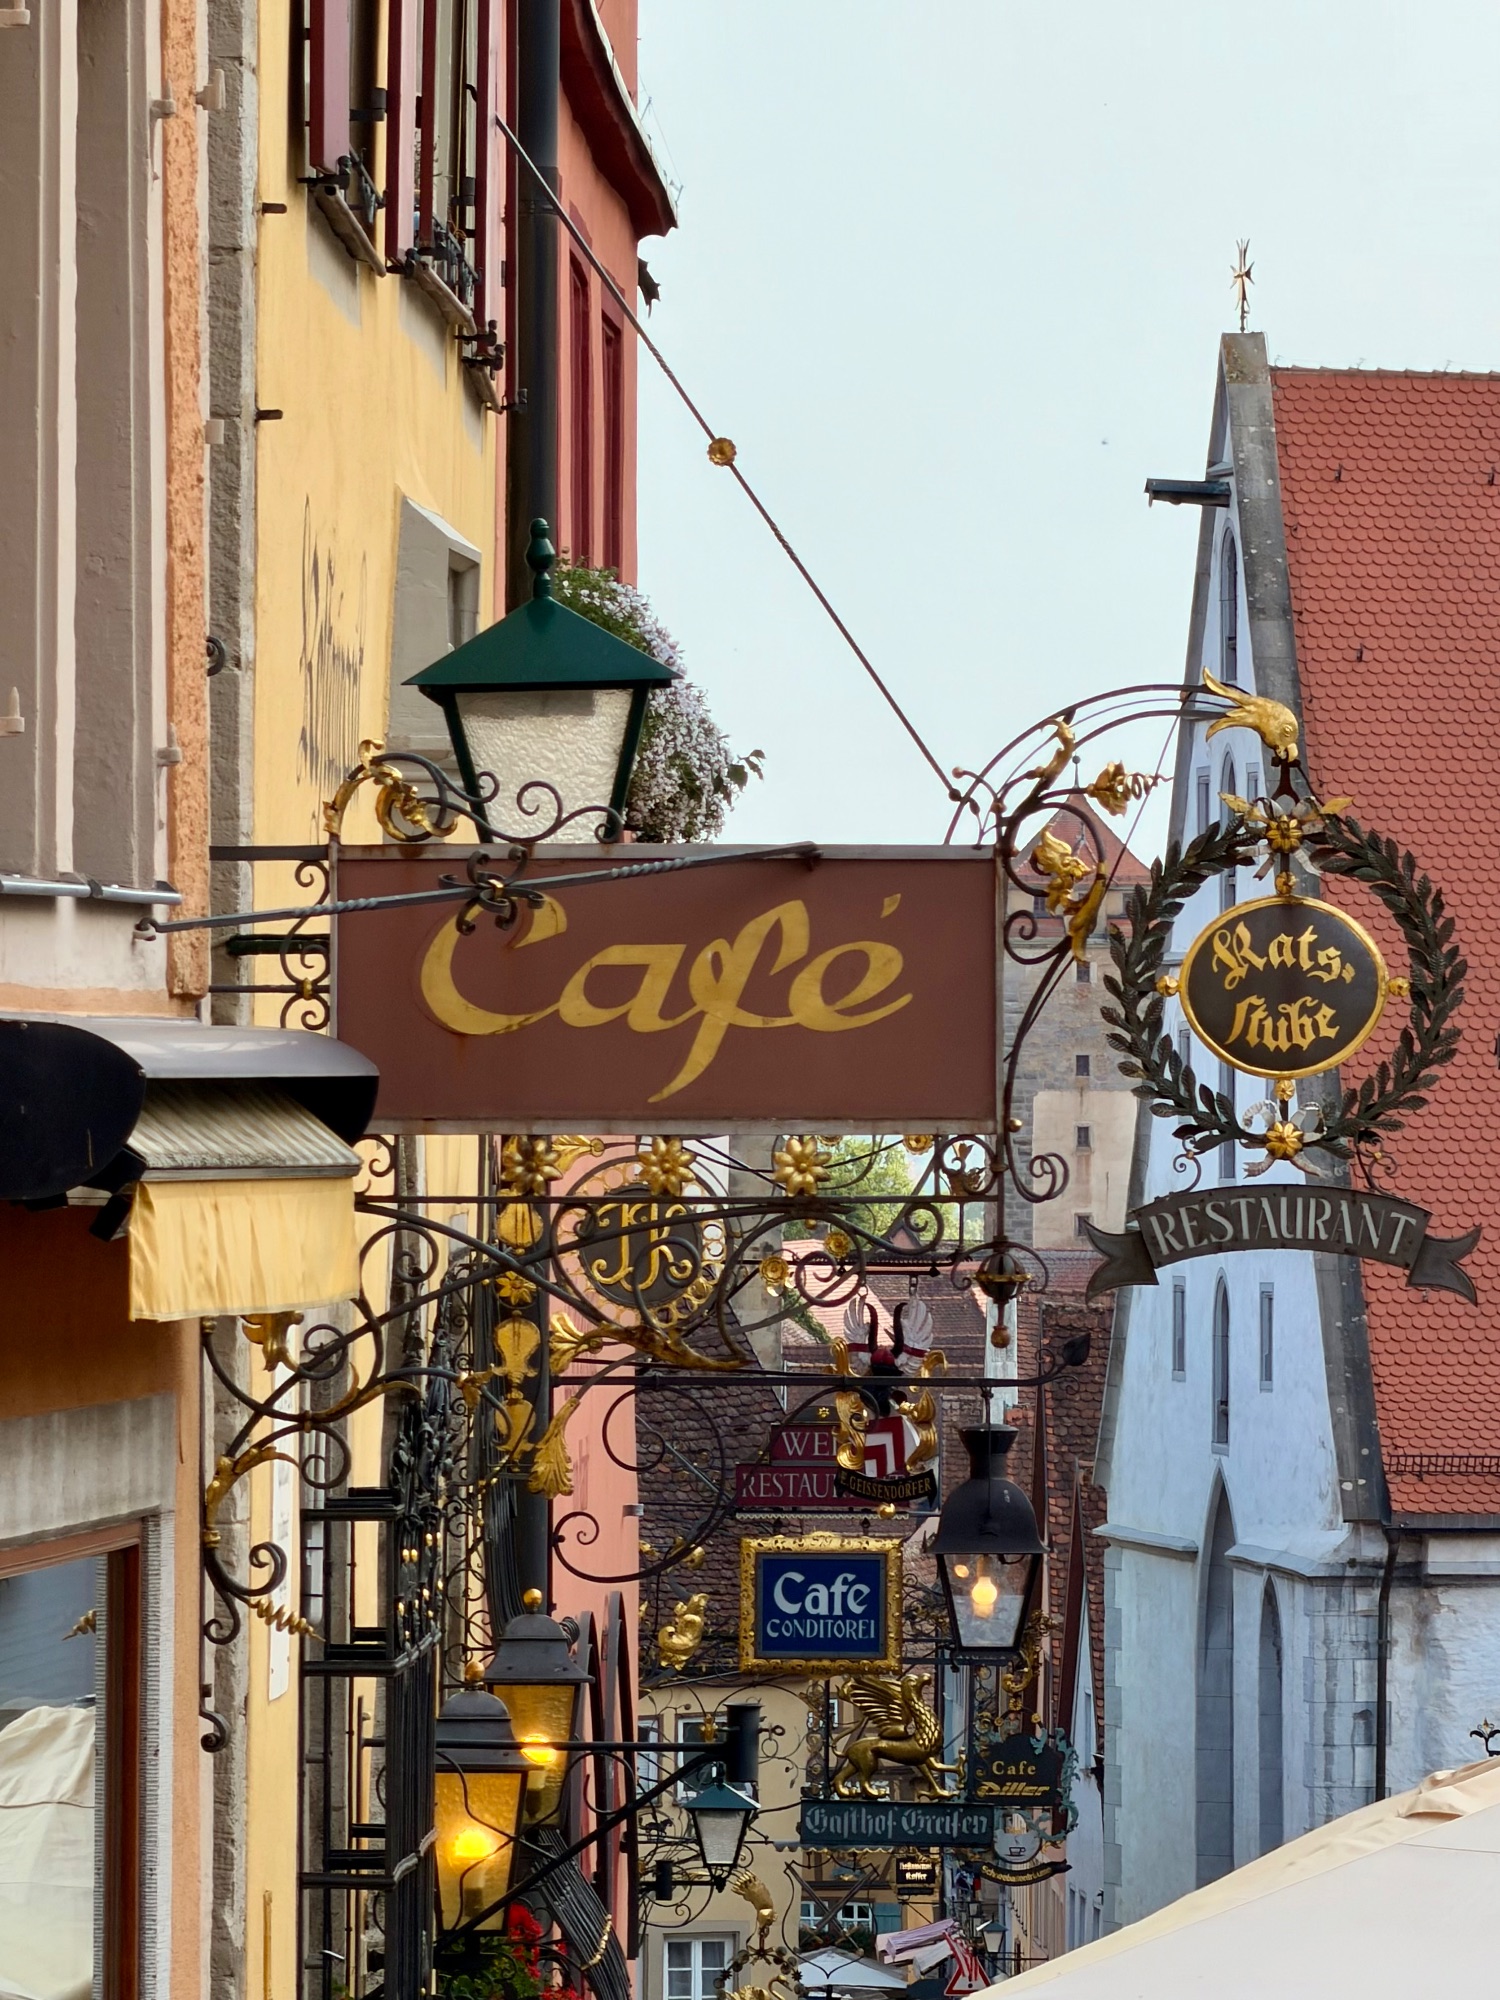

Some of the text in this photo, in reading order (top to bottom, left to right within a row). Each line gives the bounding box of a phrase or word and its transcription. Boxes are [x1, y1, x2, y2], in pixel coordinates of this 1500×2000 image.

[420, 892, 914, 1103] Café
[1149, 1196, 1417, 1257] RESTAURANT
[773, 1571, 871, 1616] Cafe
[766, 1618, 875, 1641] CONDITOREI
[991, 1760, 1037, 1776] Cafe
[976, 1781, 1051, 1798] Diller
[805, 1805, 988, 1840] Gasthof Greifen
